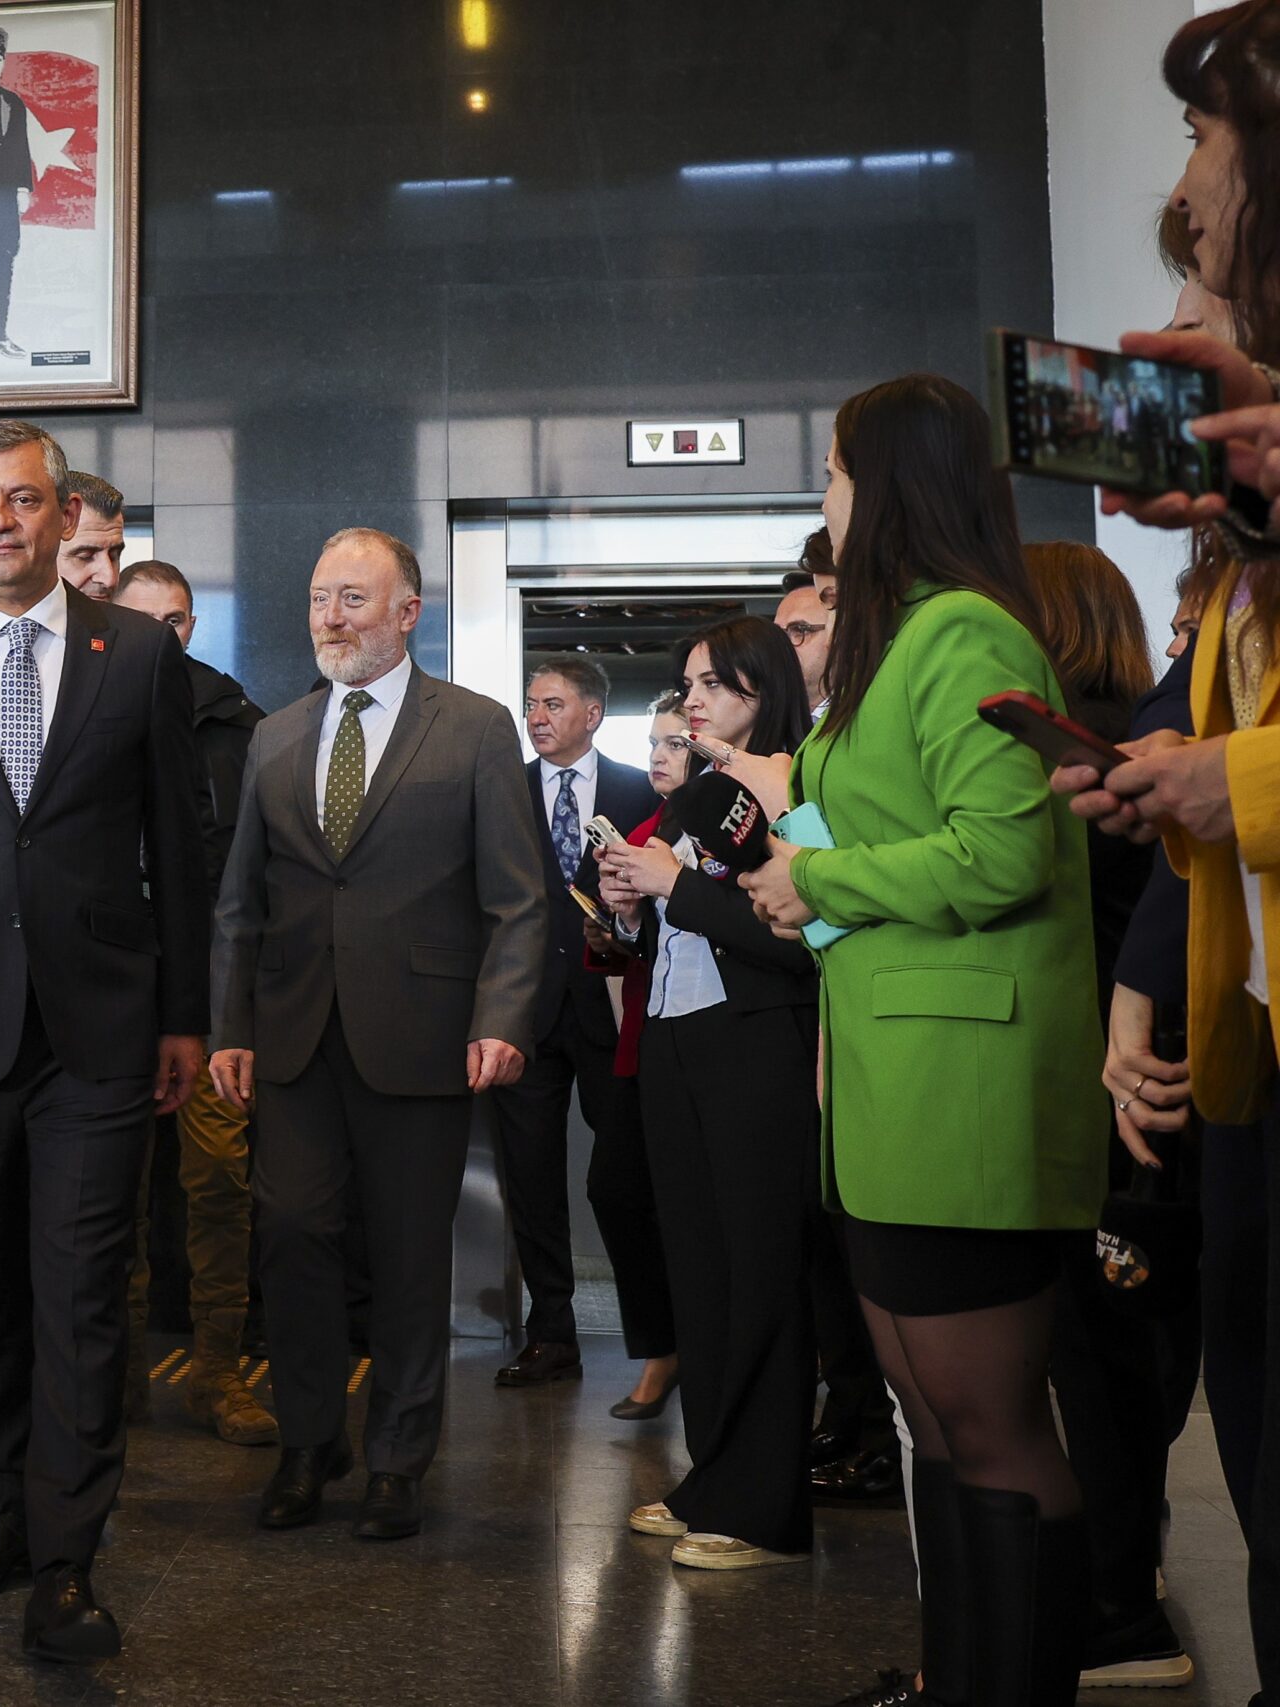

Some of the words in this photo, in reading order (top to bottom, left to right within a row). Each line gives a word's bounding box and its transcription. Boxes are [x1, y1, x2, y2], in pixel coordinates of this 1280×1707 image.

[720, 790, 750, 832] TRT
[734, 803, 757, 844] HABER
[704, 861, 725, 875] SZC
